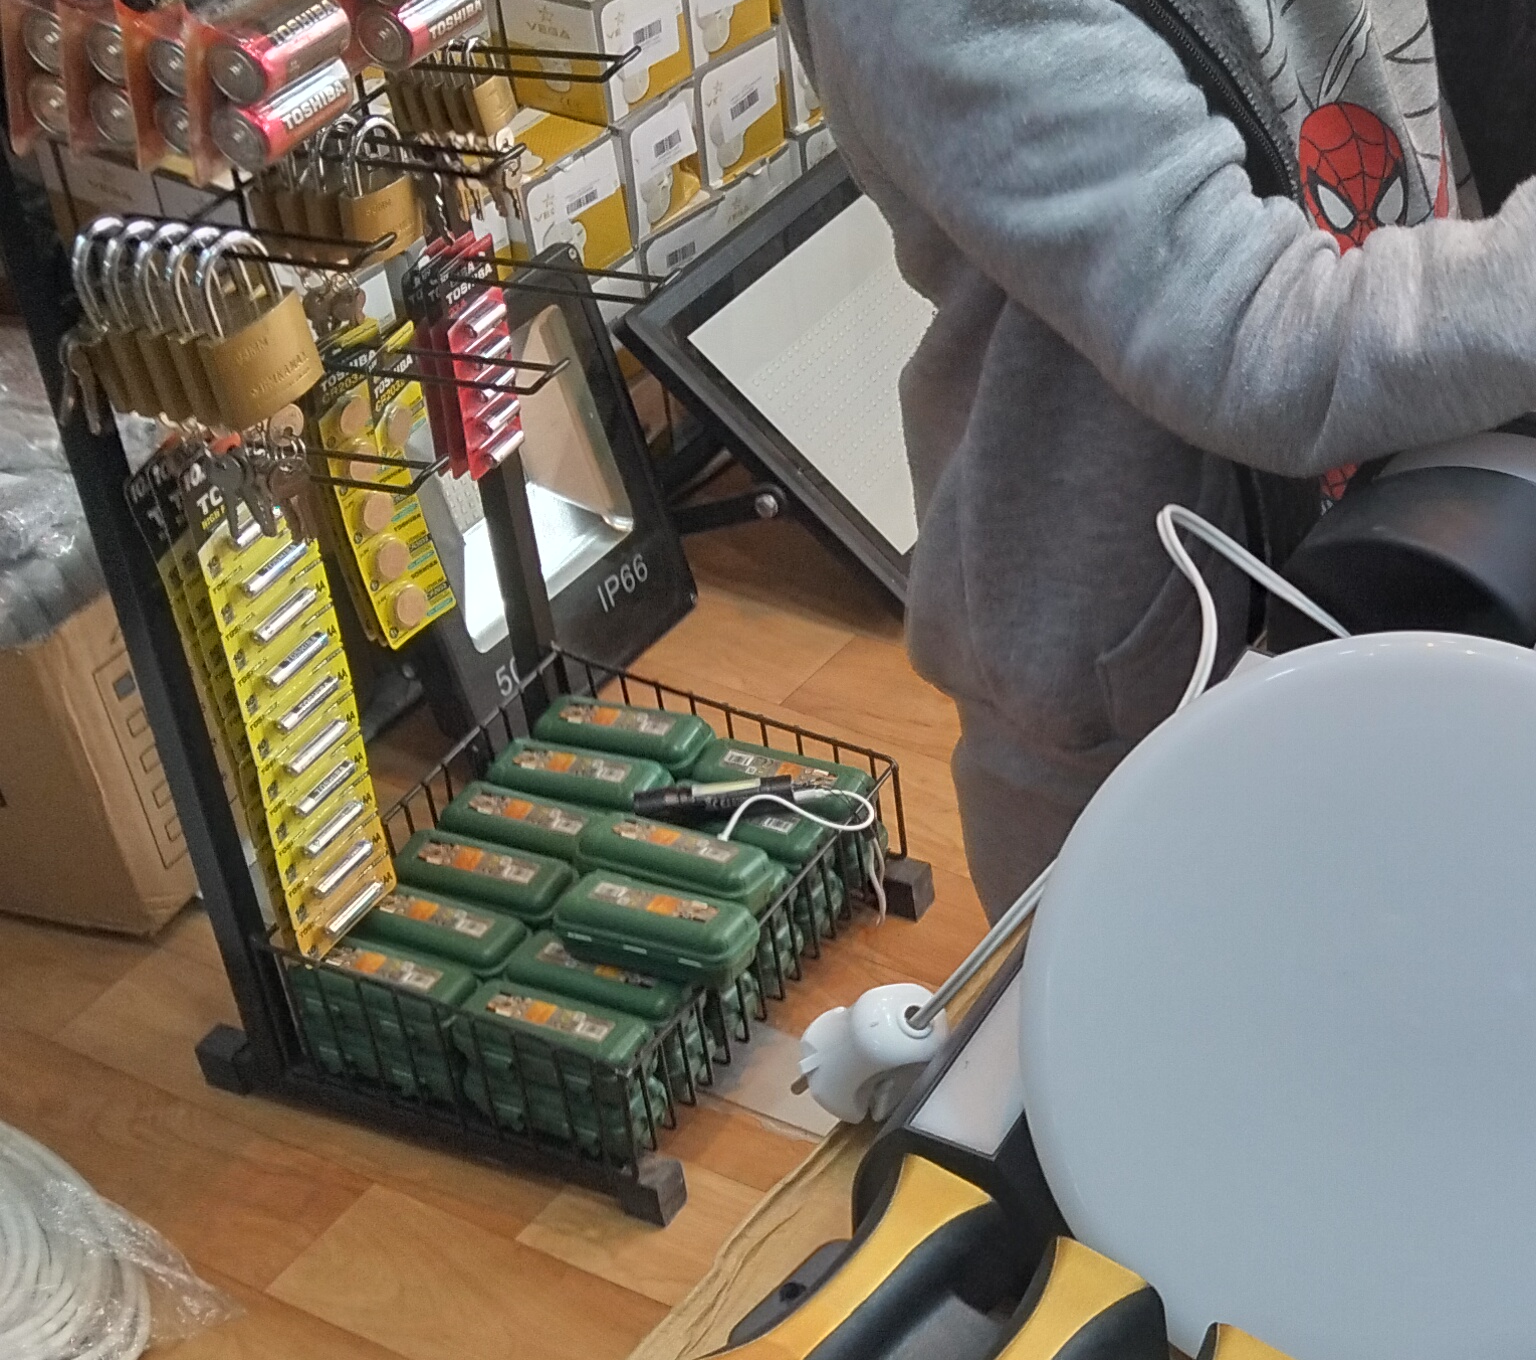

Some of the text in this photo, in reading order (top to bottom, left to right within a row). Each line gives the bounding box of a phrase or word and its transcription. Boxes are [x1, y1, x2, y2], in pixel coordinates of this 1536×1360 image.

[606, 25, 622, 40] VE
[282, 79, 346, 130] TOSHIBA
[534, 210, 555, 225] VE
[597, 553, 648, 613] IP66
